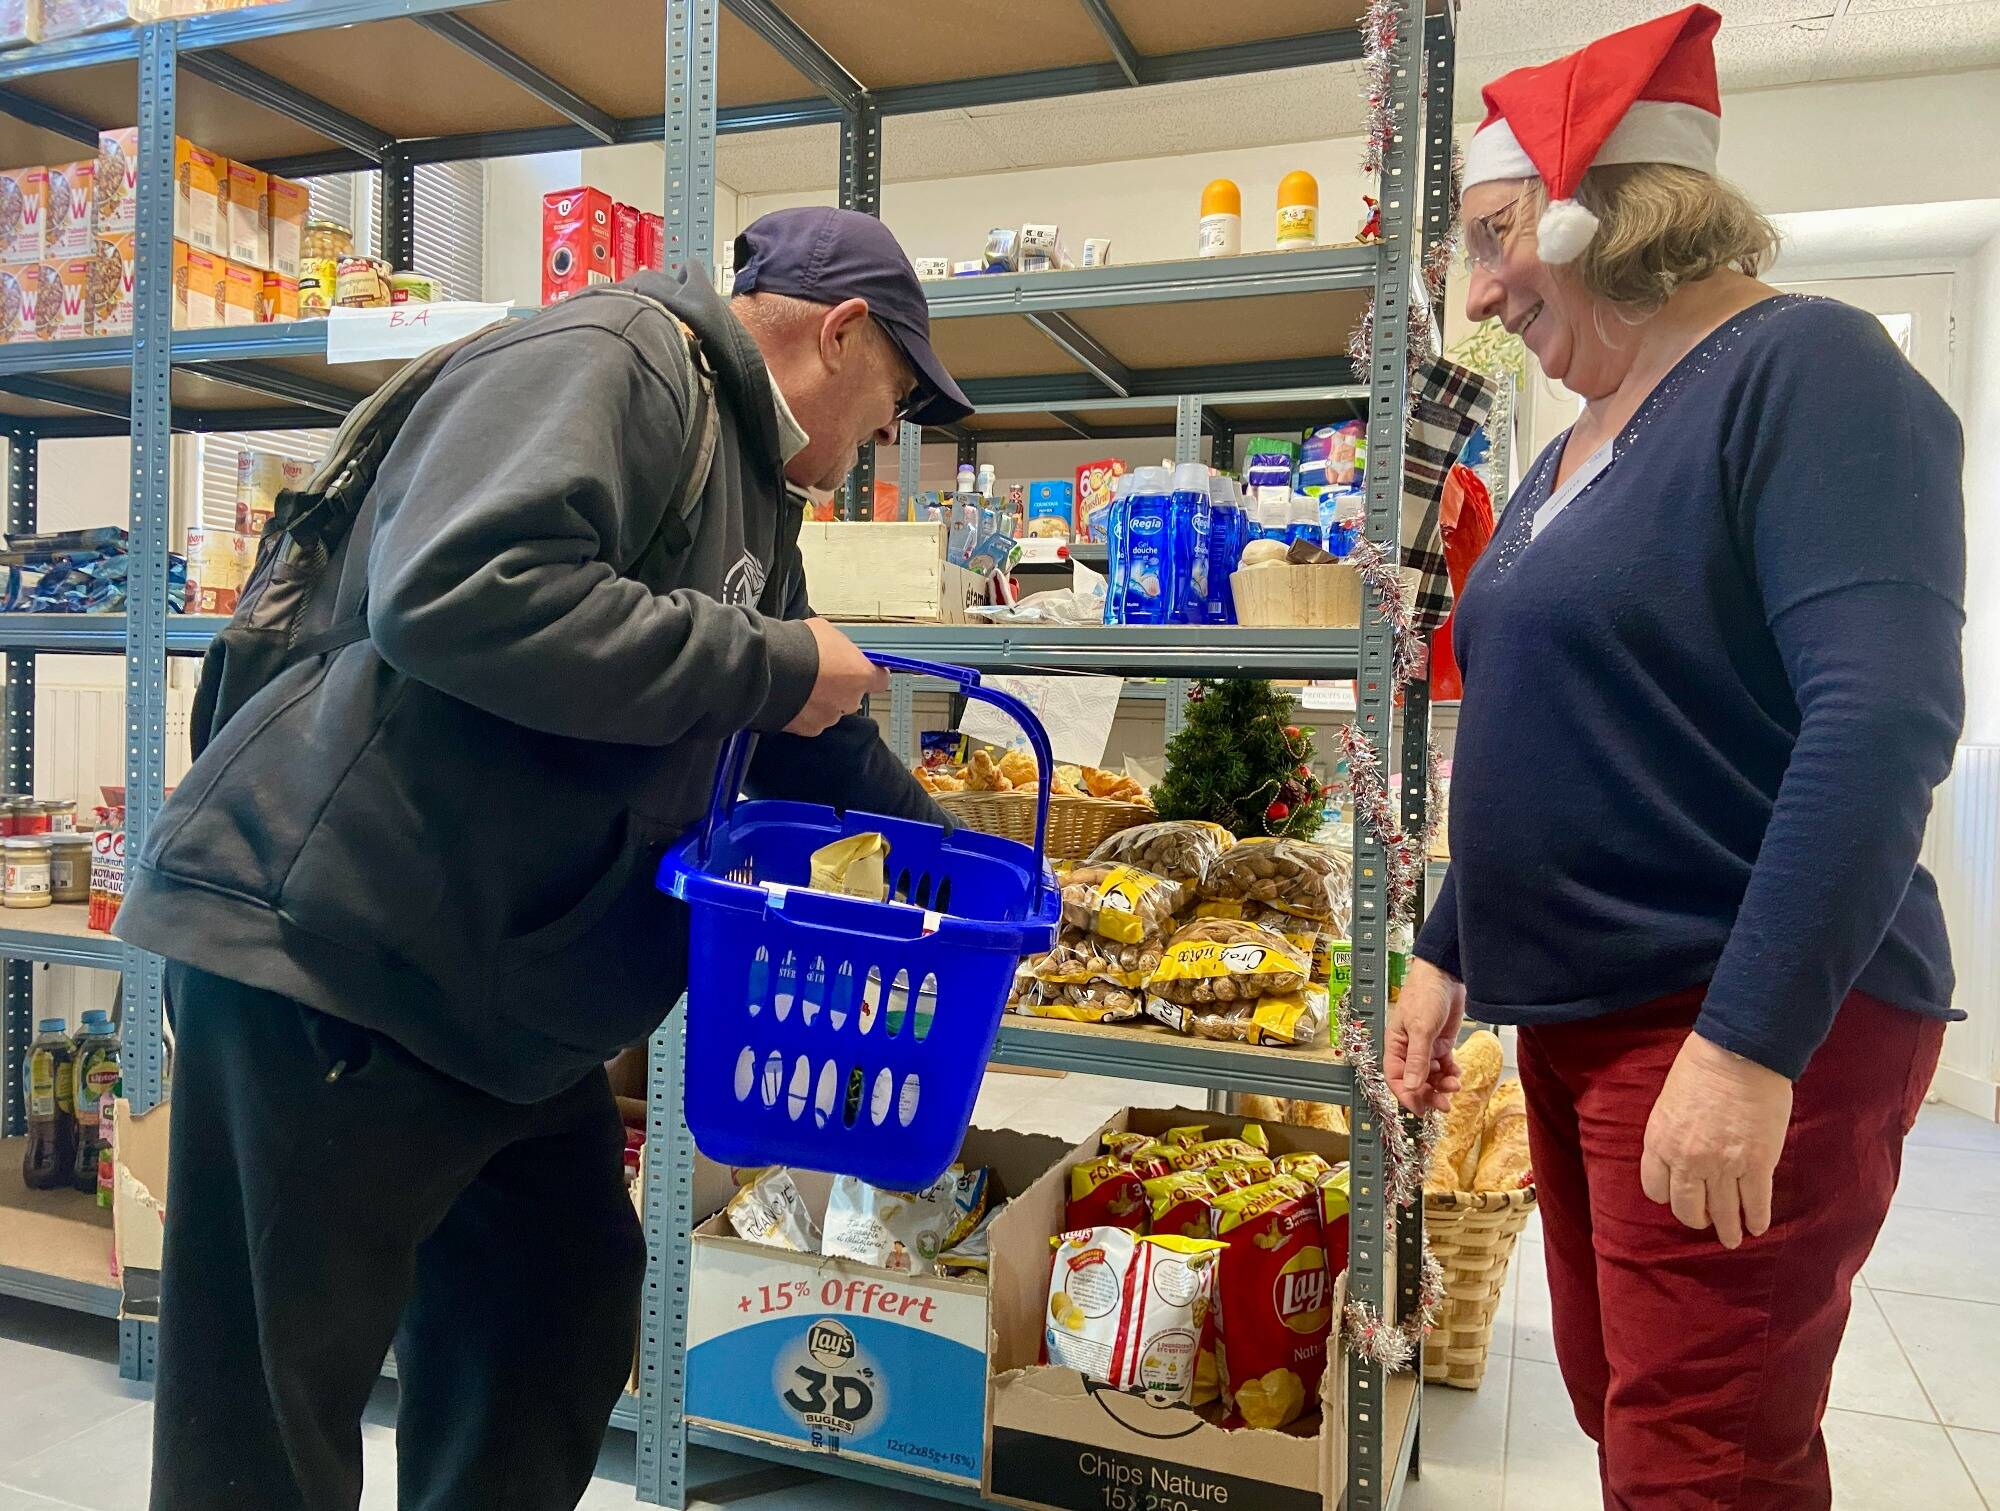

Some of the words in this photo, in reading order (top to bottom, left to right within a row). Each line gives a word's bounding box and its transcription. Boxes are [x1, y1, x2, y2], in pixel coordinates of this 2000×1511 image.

[390, 309, 430, 327] B.A
[1132, 519, 1161, 529] Regia
[1132, 547, 1158, 555] douche
[1284, 1216, 1294, 1230] 3
[821, 1279, 937, 1323] Offert
[1282, 1270, 1325, 1316] Lay
[806, 1414, 851, 1431] BUGLES
[1079, 1452, 1143, 1487] Chips
[1151, 1466, 1228, 1504] Nature
